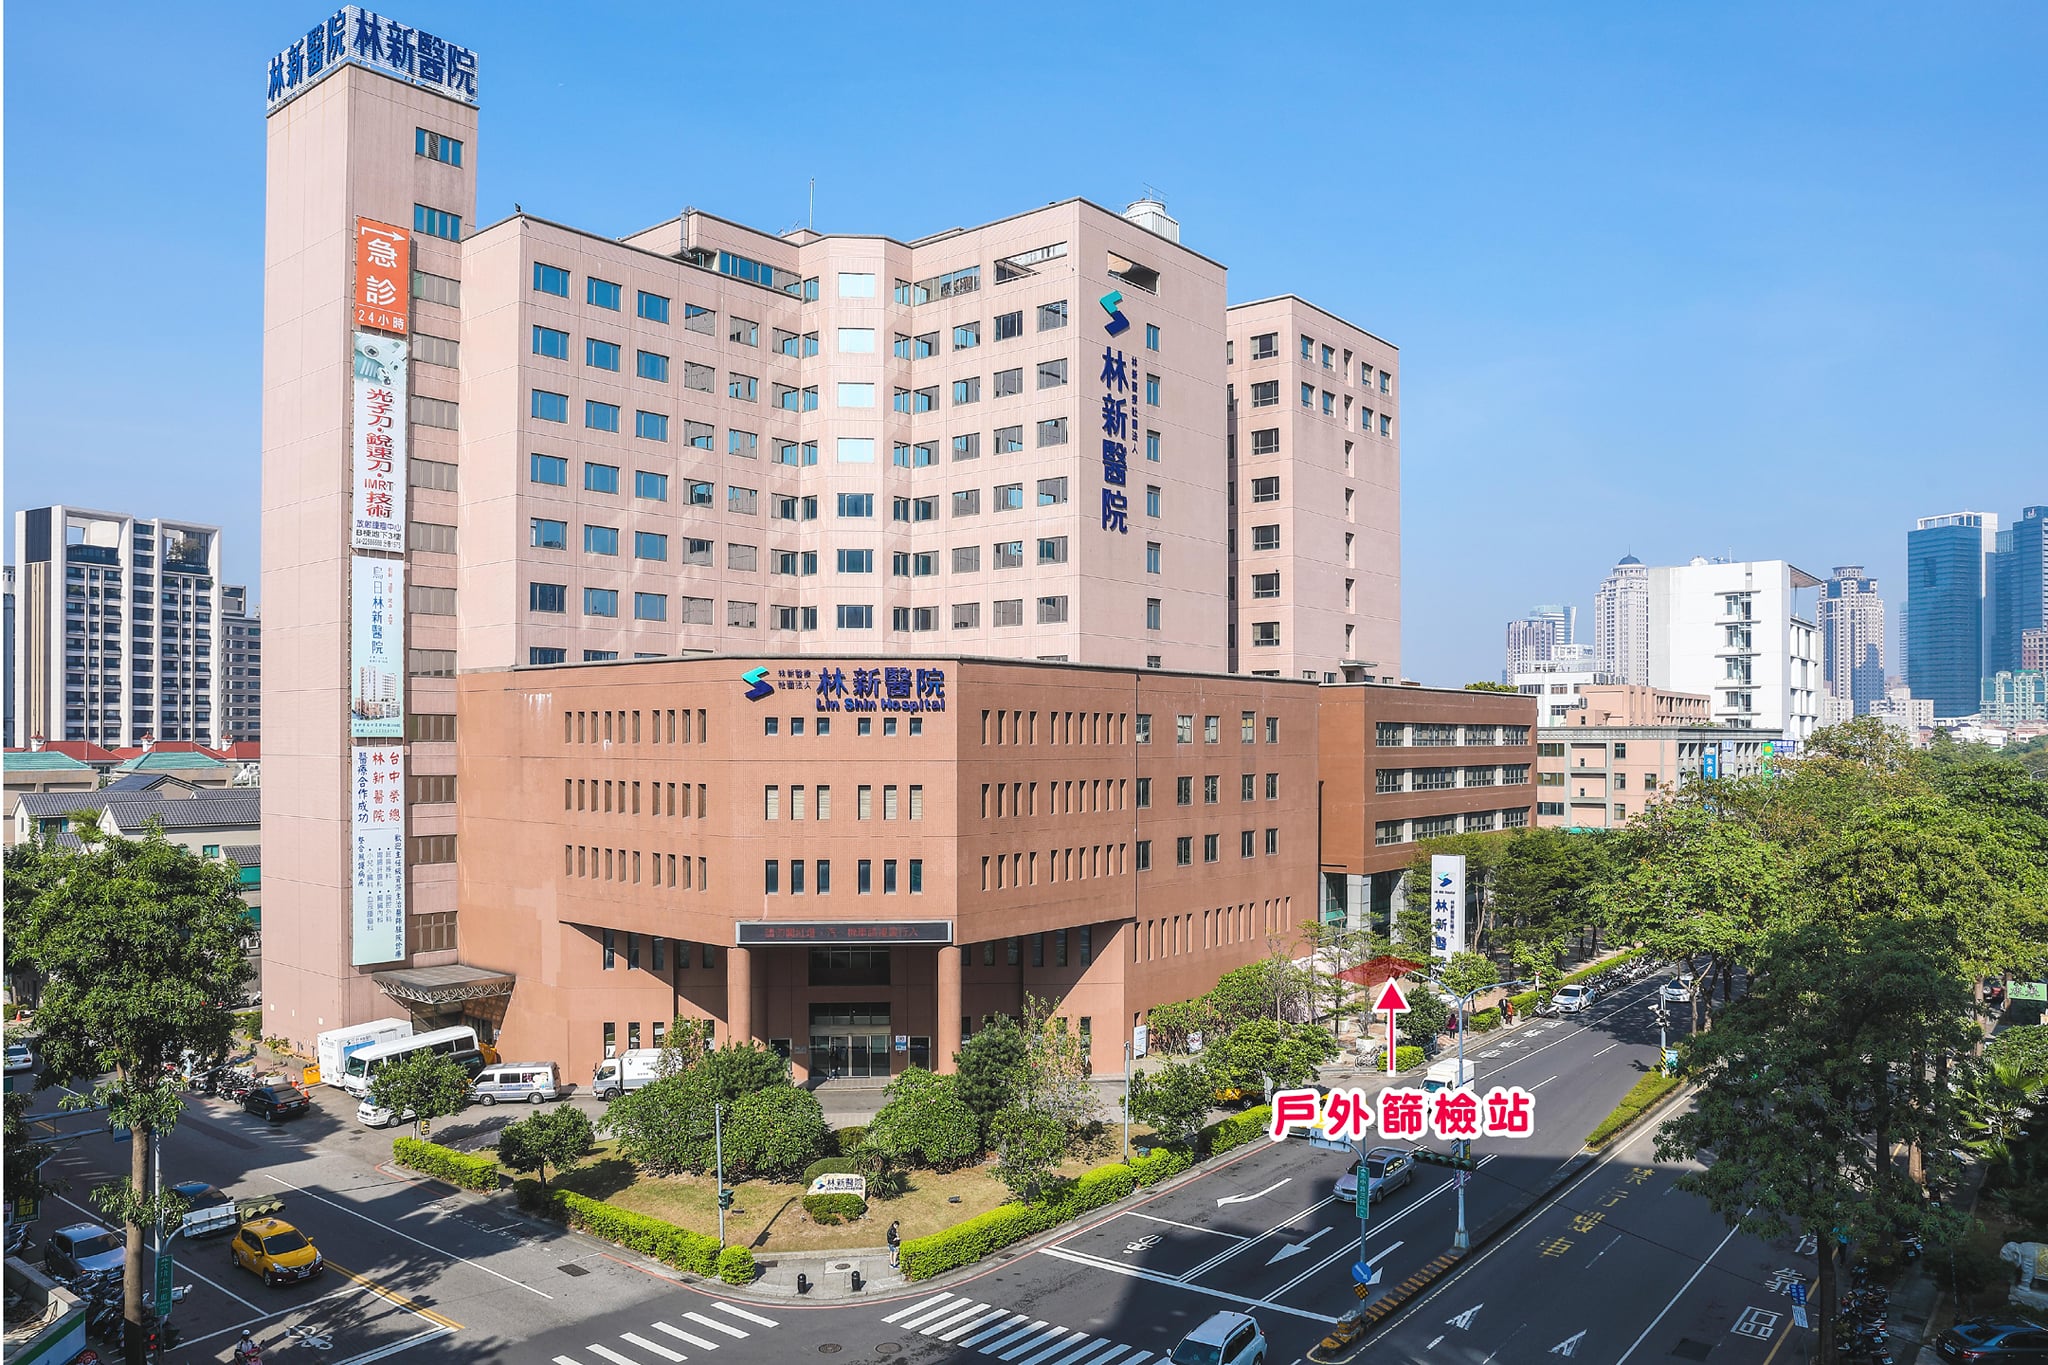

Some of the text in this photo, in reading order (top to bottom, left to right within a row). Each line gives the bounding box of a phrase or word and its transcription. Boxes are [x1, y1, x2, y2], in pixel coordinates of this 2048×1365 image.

[268, 9, 346, 101] 林新醫院
[353, 8, 476, 95] 林新醫院
[366, 238, 398, 305] 急診
[358, 309, 404, 330] 24小時
[1100, 346, 1129, 534] 林新醫院
[364, 478, 394, 491] IMRT
[816, 667, 945, 699] 林新醫院
[816, 698, 945, 715] Lin Shin Hospital
[372, 751, 385, 823] 林新醫院
[389, 751, 400, 822] 台中榮總
[827, 1177, 863, 1187] 林新醫院
